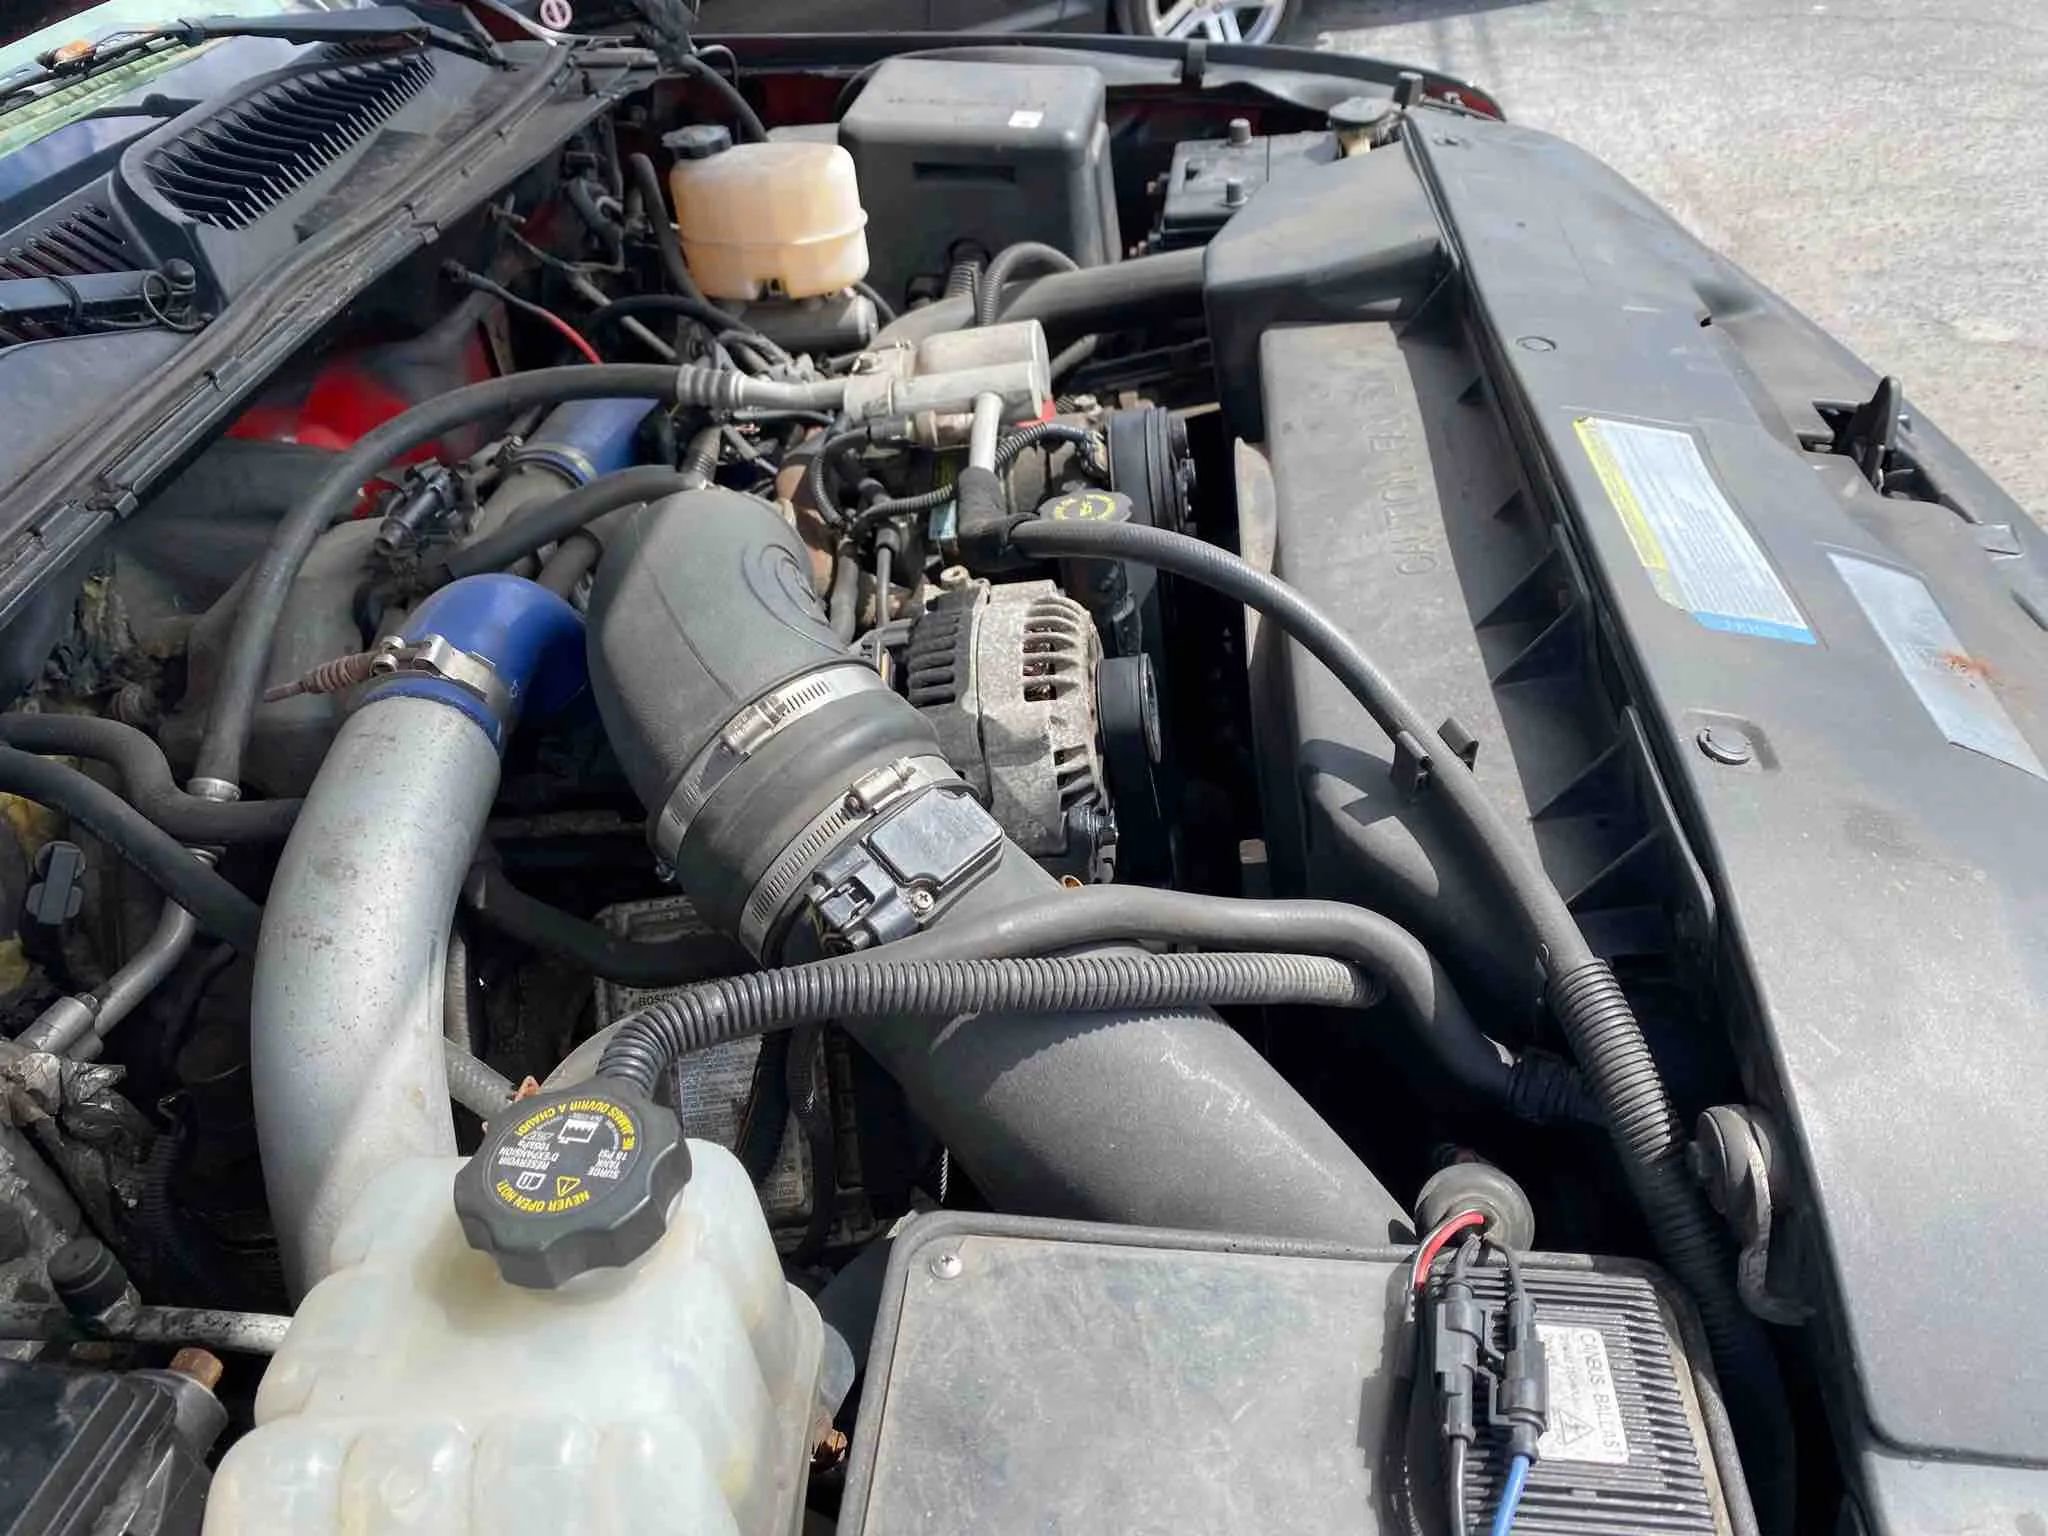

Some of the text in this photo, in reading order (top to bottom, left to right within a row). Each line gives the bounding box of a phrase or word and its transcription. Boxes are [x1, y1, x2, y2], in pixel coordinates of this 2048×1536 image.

[569, 1099, 610, 1113] OUVRIR
[514, 1194, 546, 1212] OPEN
[548, 1189, 591, 1212] NEVER
[1593, 1393, 1624, 1458] BALLAST
